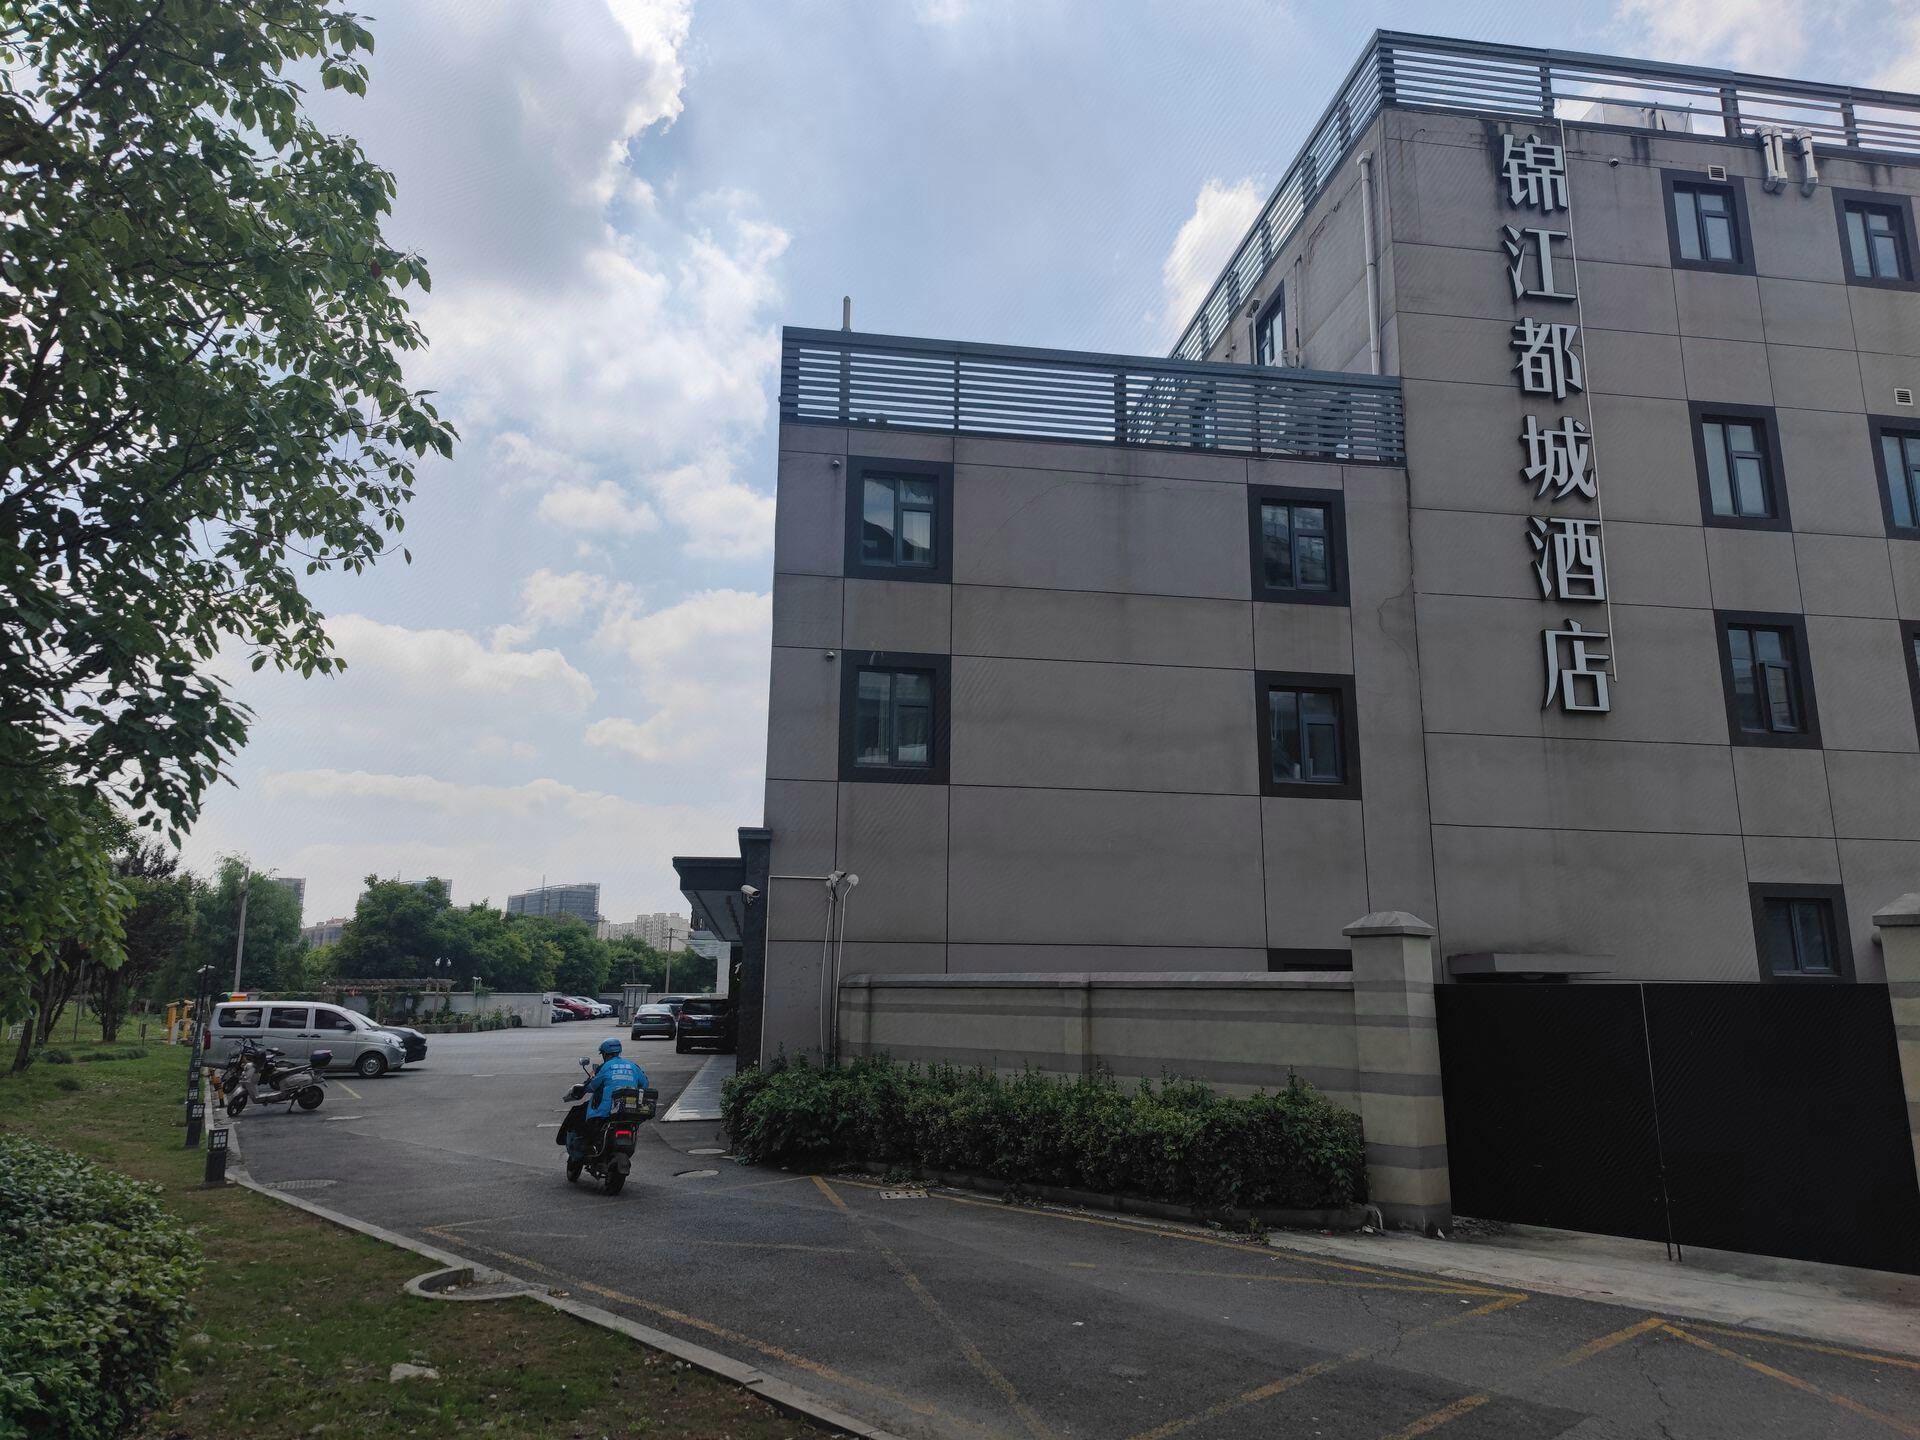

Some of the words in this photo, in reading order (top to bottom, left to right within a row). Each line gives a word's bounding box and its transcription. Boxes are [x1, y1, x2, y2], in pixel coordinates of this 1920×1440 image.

[1502, 133, 1611, 713] 锦江都城酒店
